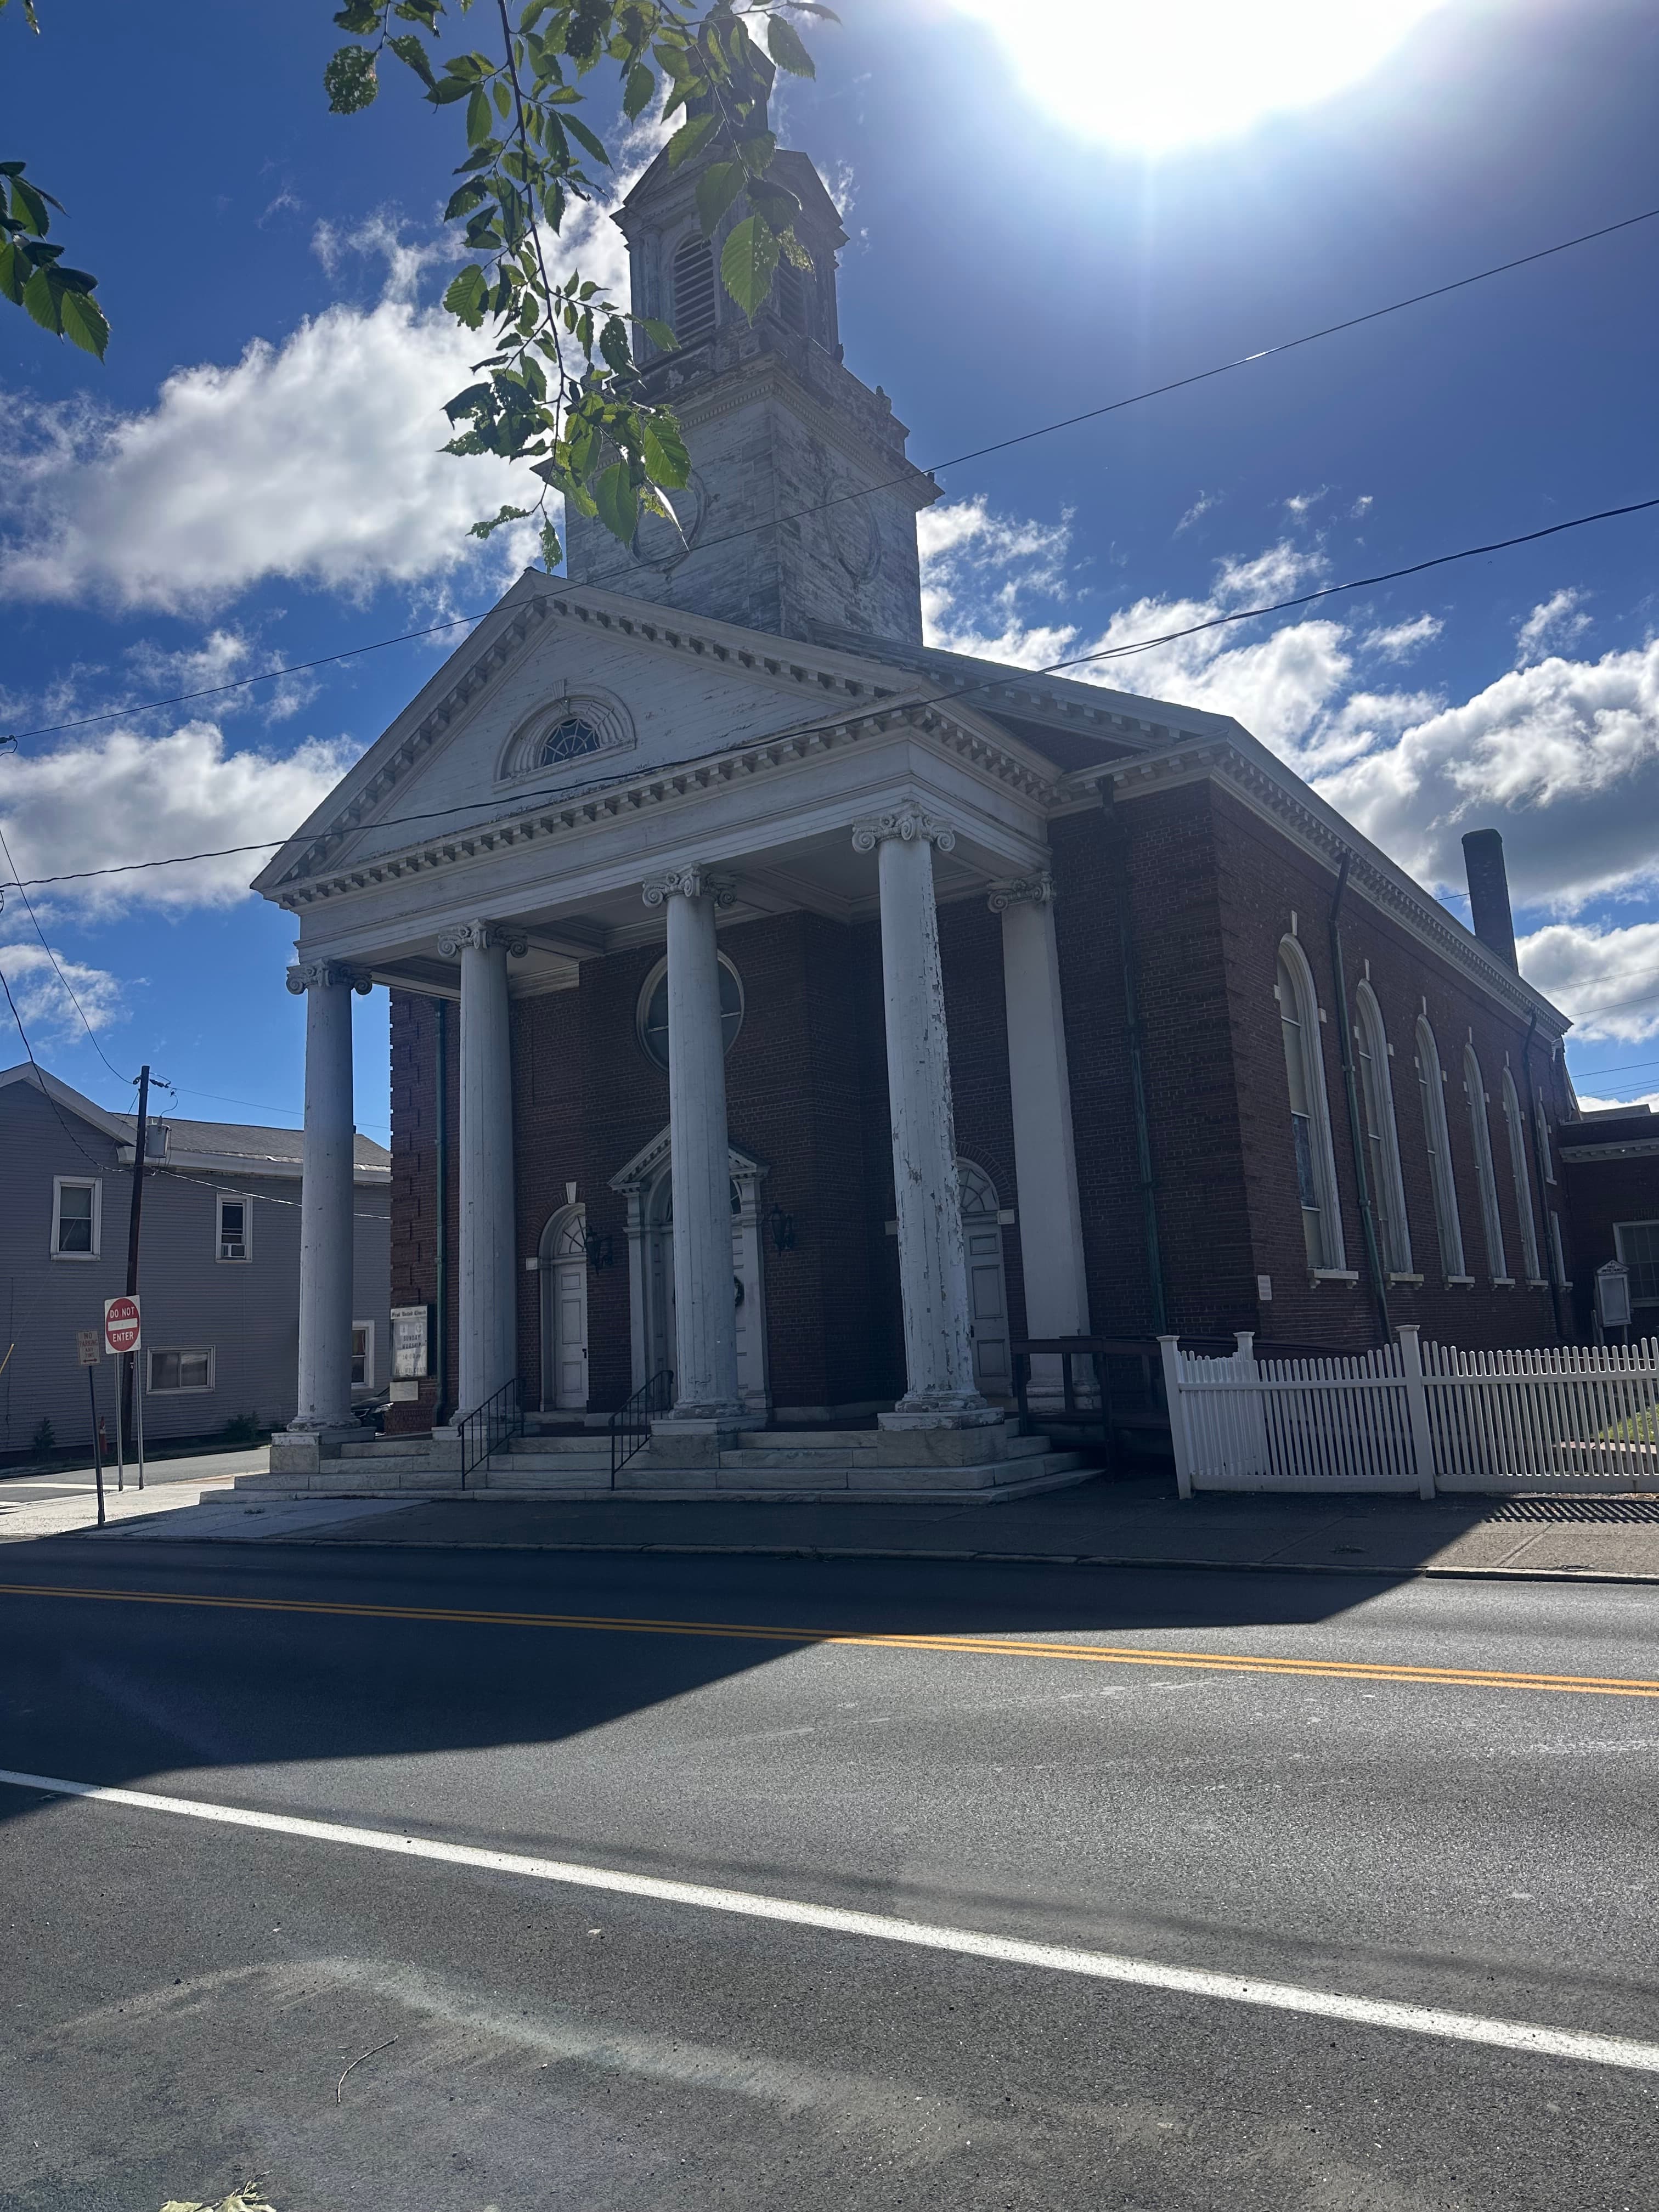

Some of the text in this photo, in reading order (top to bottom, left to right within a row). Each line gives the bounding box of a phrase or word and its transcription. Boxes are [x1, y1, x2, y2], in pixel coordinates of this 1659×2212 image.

[110, 1306, 135, 1318] DO NOT
[112, 1331, 134, 1342] ENTER
